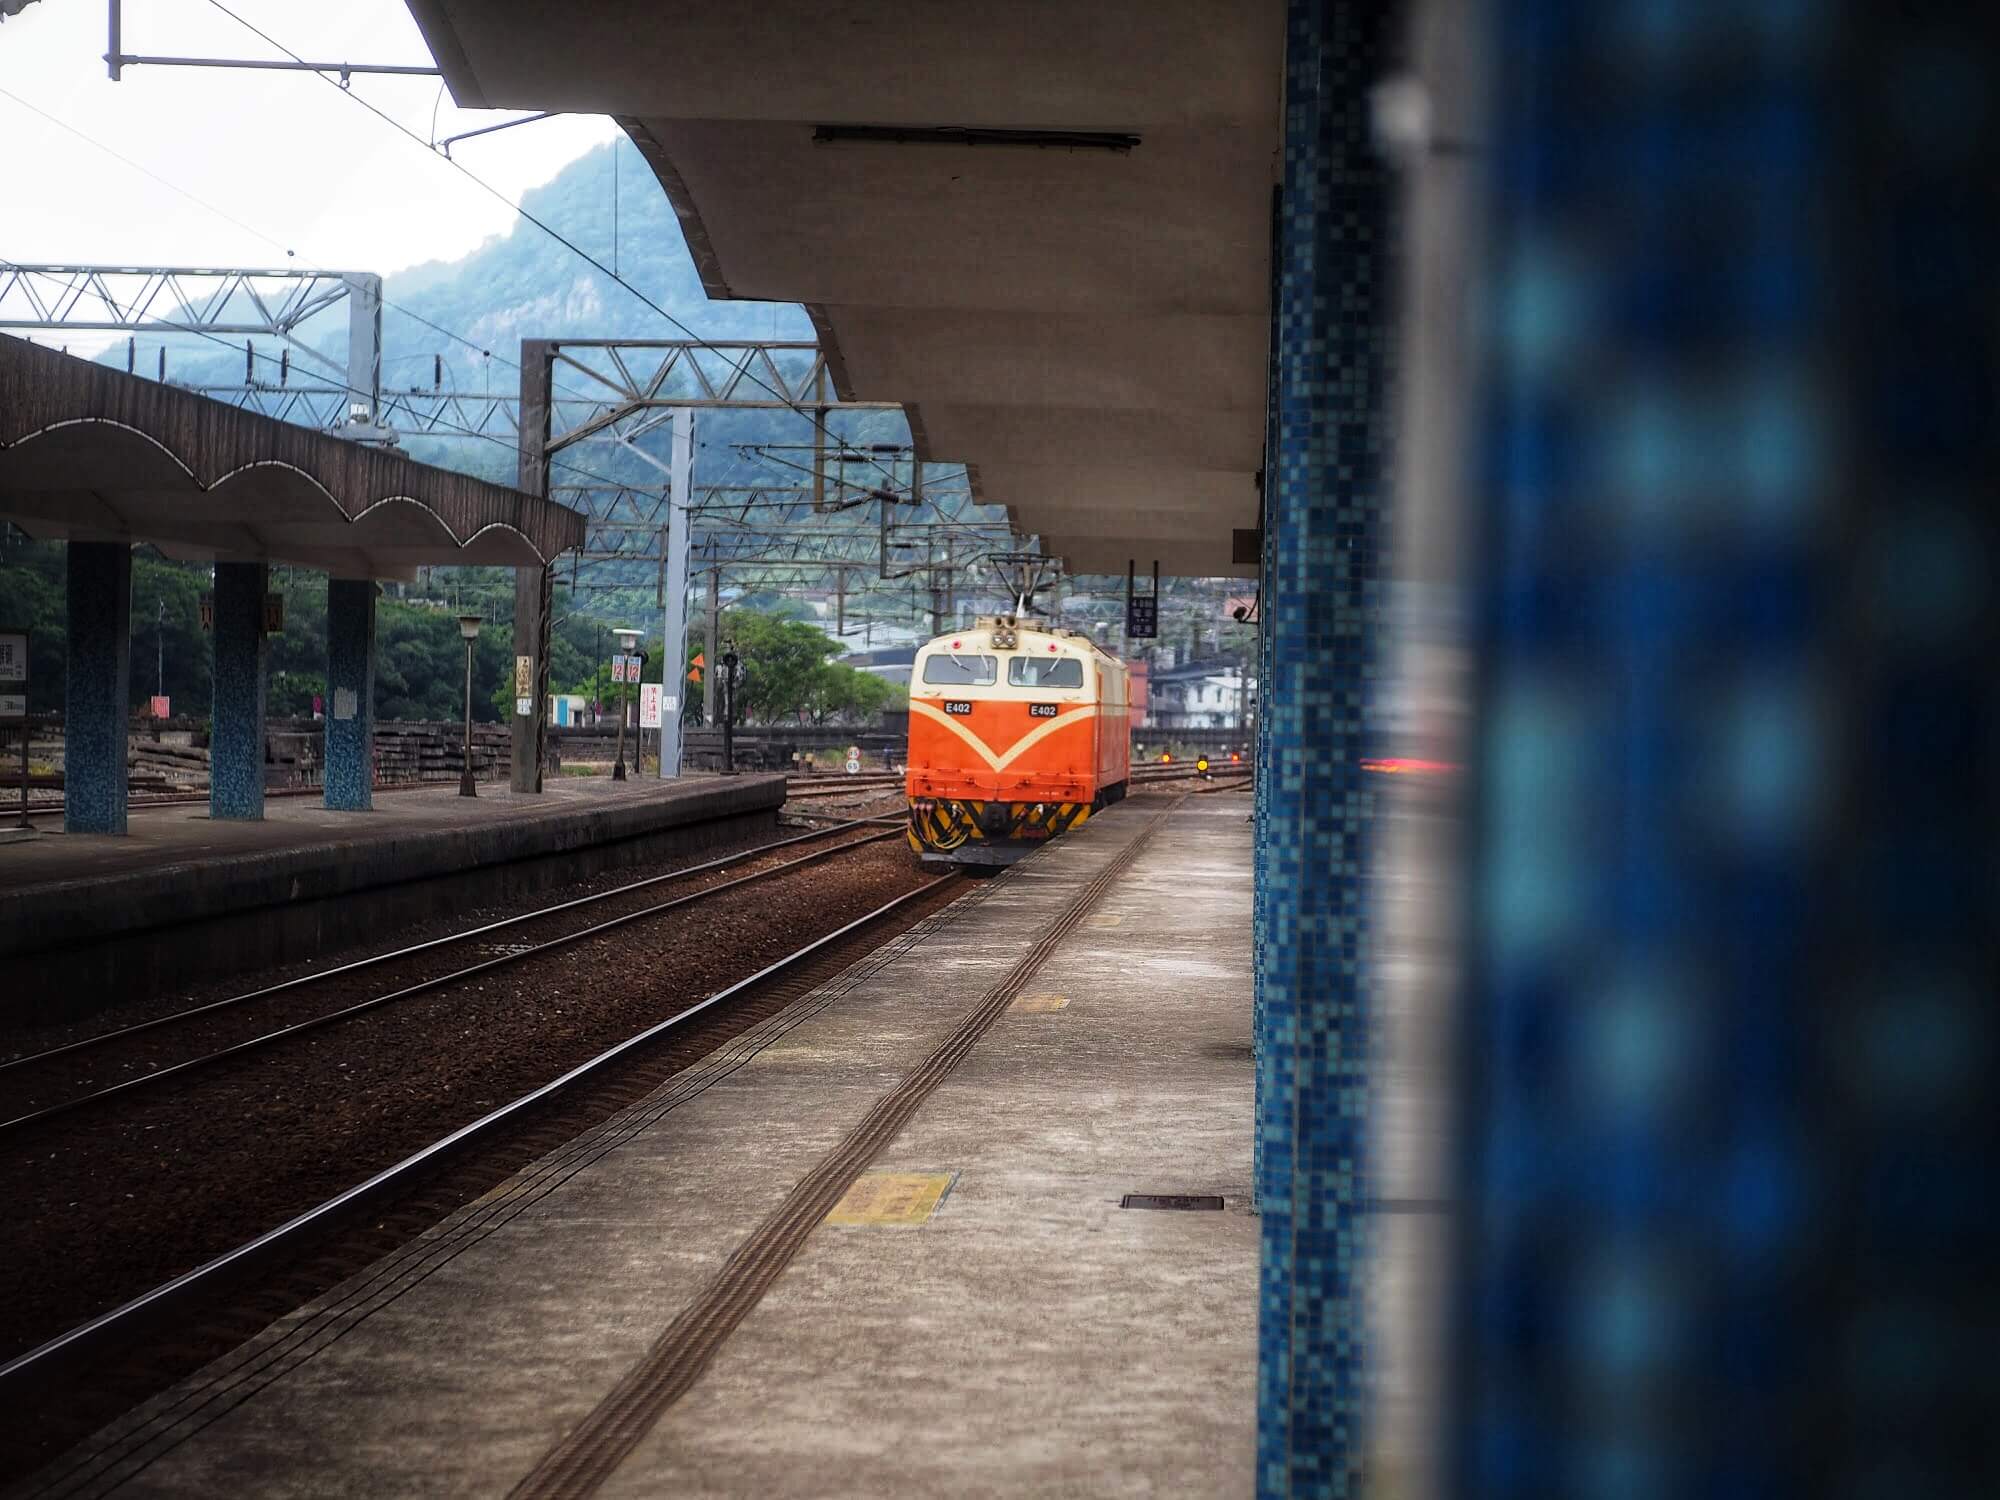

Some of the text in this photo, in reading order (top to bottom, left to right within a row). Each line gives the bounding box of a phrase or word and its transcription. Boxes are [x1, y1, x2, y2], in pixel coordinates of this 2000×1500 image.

[614, 664, 622, 676] 12
[629, 665, 639, 677] 12
[945, 703, 970, 713] E402
[1030, 706, 1056, 715] E402
